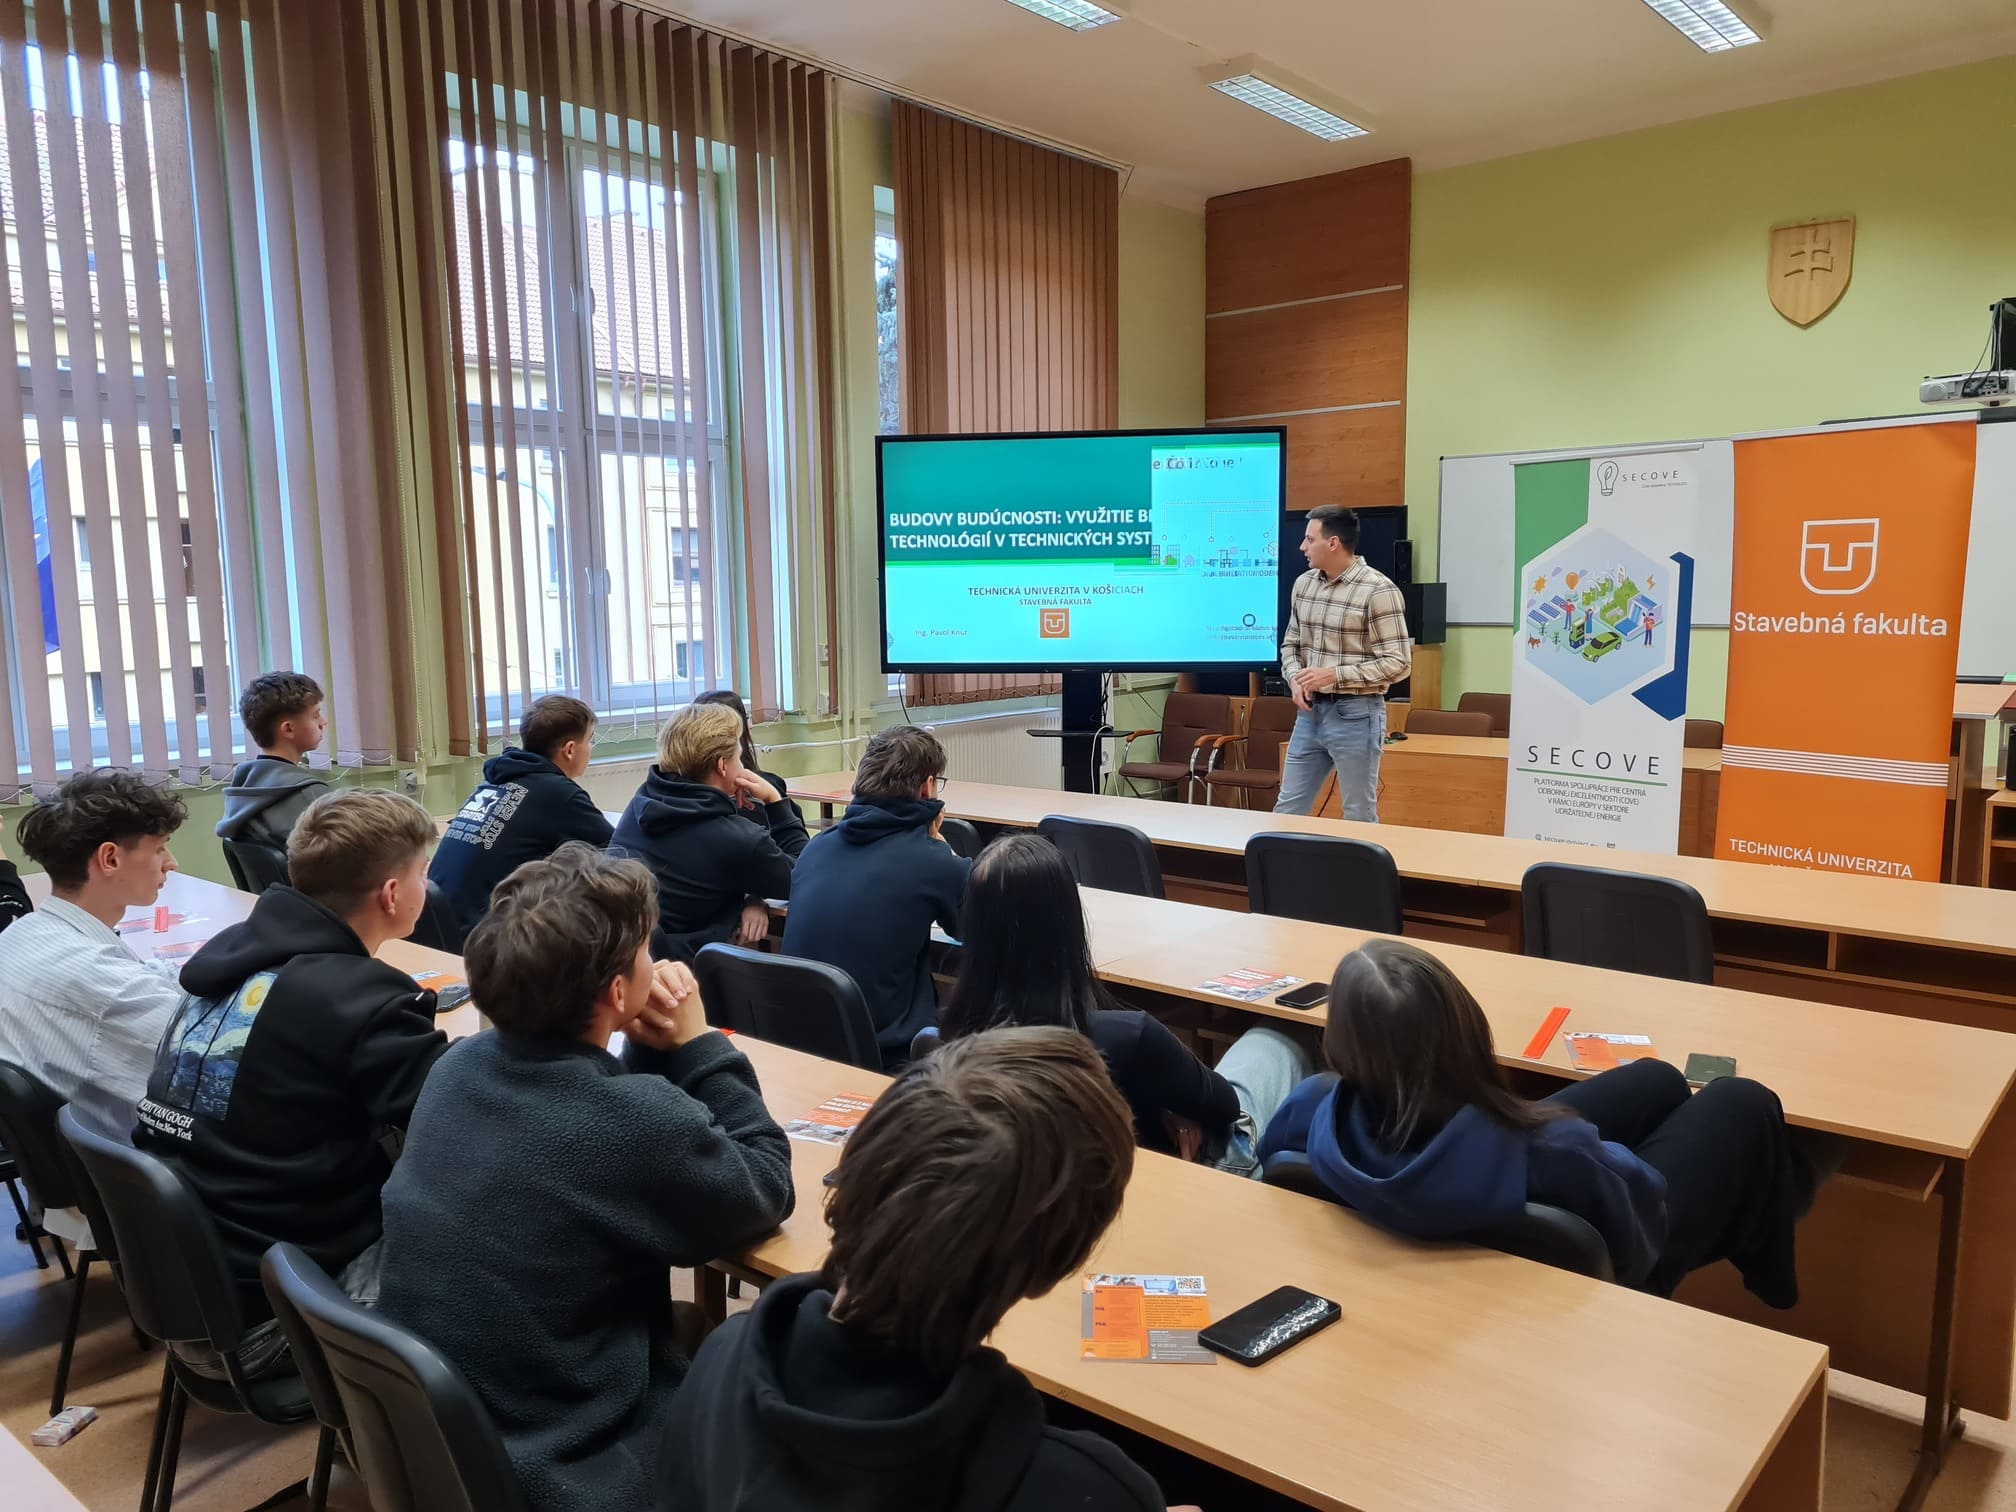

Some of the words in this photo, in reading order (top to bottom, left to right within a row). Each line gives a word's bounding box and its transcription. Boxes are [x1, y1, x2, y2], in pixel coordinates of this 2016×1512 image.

[1622, 470, 1679, 482] SECOVE
[889, 512, 953, 527] BUDOVY
[957, 508, 1062, 526] BUDÚCNOSTI:
[1066, 507, 1134, 524] VYUŽITIE
[889, 530, 992, 548] TECHNOLÓGIÍ
[994, 533, 1006, 547] V
[1008, 529, 1113, 547] TECHNICKÝCH
[968, 585, 1021, 597] TECHNICKÁ
[1024, 586, 1080, 596] UNIVERZITA
[1083, 586, 1090, 595] V
[1092, 584, 1144, 595] KOŠICIACH
[1019, 597, 1058, 606] STAVEBNÁ
[1059, 598, 1092, 606] FAKULTA
[1733, 611, 1845, 633] Stavebná
[1852, 612, 1948, 636] fakulta
[1527, 745, 1660, 776] SECOVE
[1533, 777, 1569, 788] PLATFORMA
[1610, 785, 1621, 794] PRE
[1537, 786, 1570, 798] ODBORNEJ
[1602, 803, 1629, 814] SEKTORE
[1729, 838, 1814, 864] TECHNICKÁ
[1817, 851, 1913, 879] UNIVERZITA
[165, 1111, 194, 1128] GOGH
[177, 1127, 193, 1141] York
